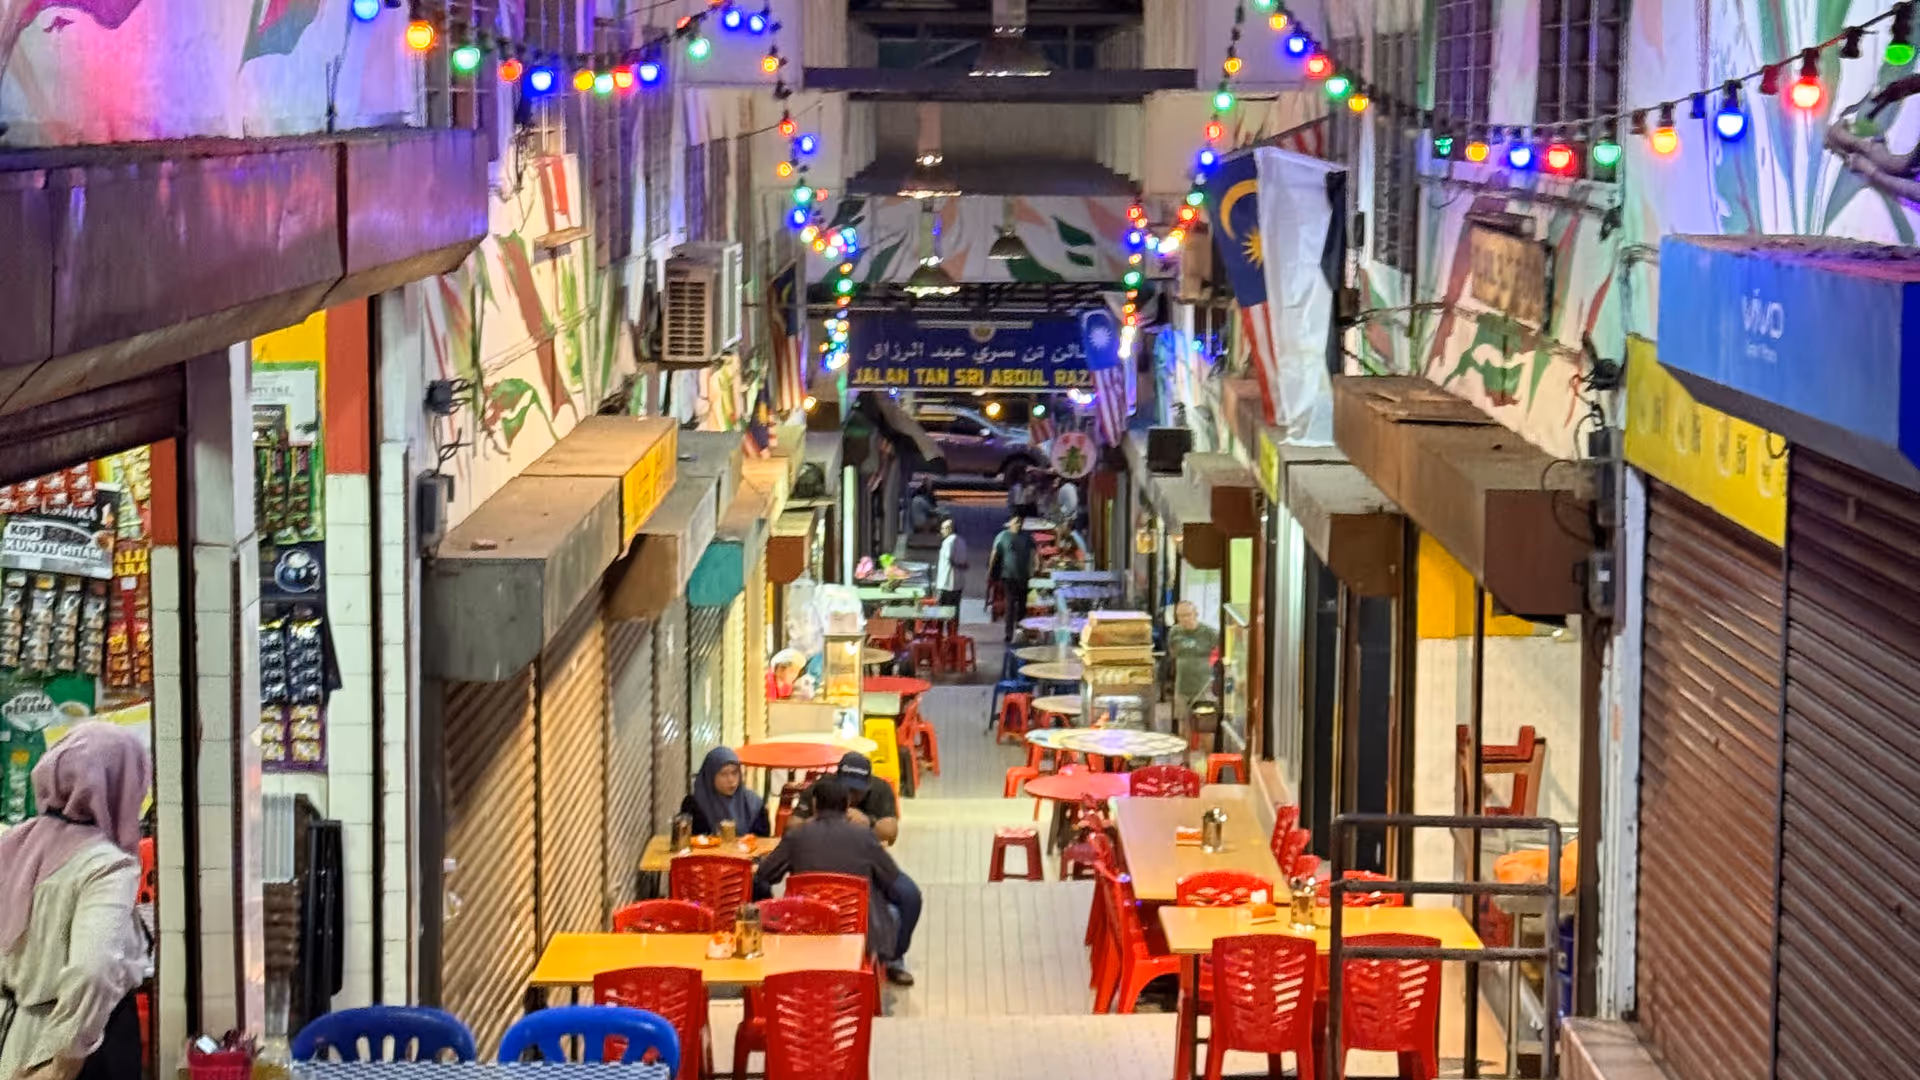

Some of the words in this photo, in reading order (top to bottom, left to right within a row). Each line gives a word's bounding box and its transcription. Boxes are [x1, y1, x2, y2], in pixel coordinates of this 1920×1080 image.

[1741, 288, 1784, 339] vivo
[930, 348, 966, 361] عبد
[852, 368, 909, 385] JALAN
[914, 368, 949, 386] TAN
[954, 368, 985, 386] SRI
[989, 368, 1049, 387] ABDUL
